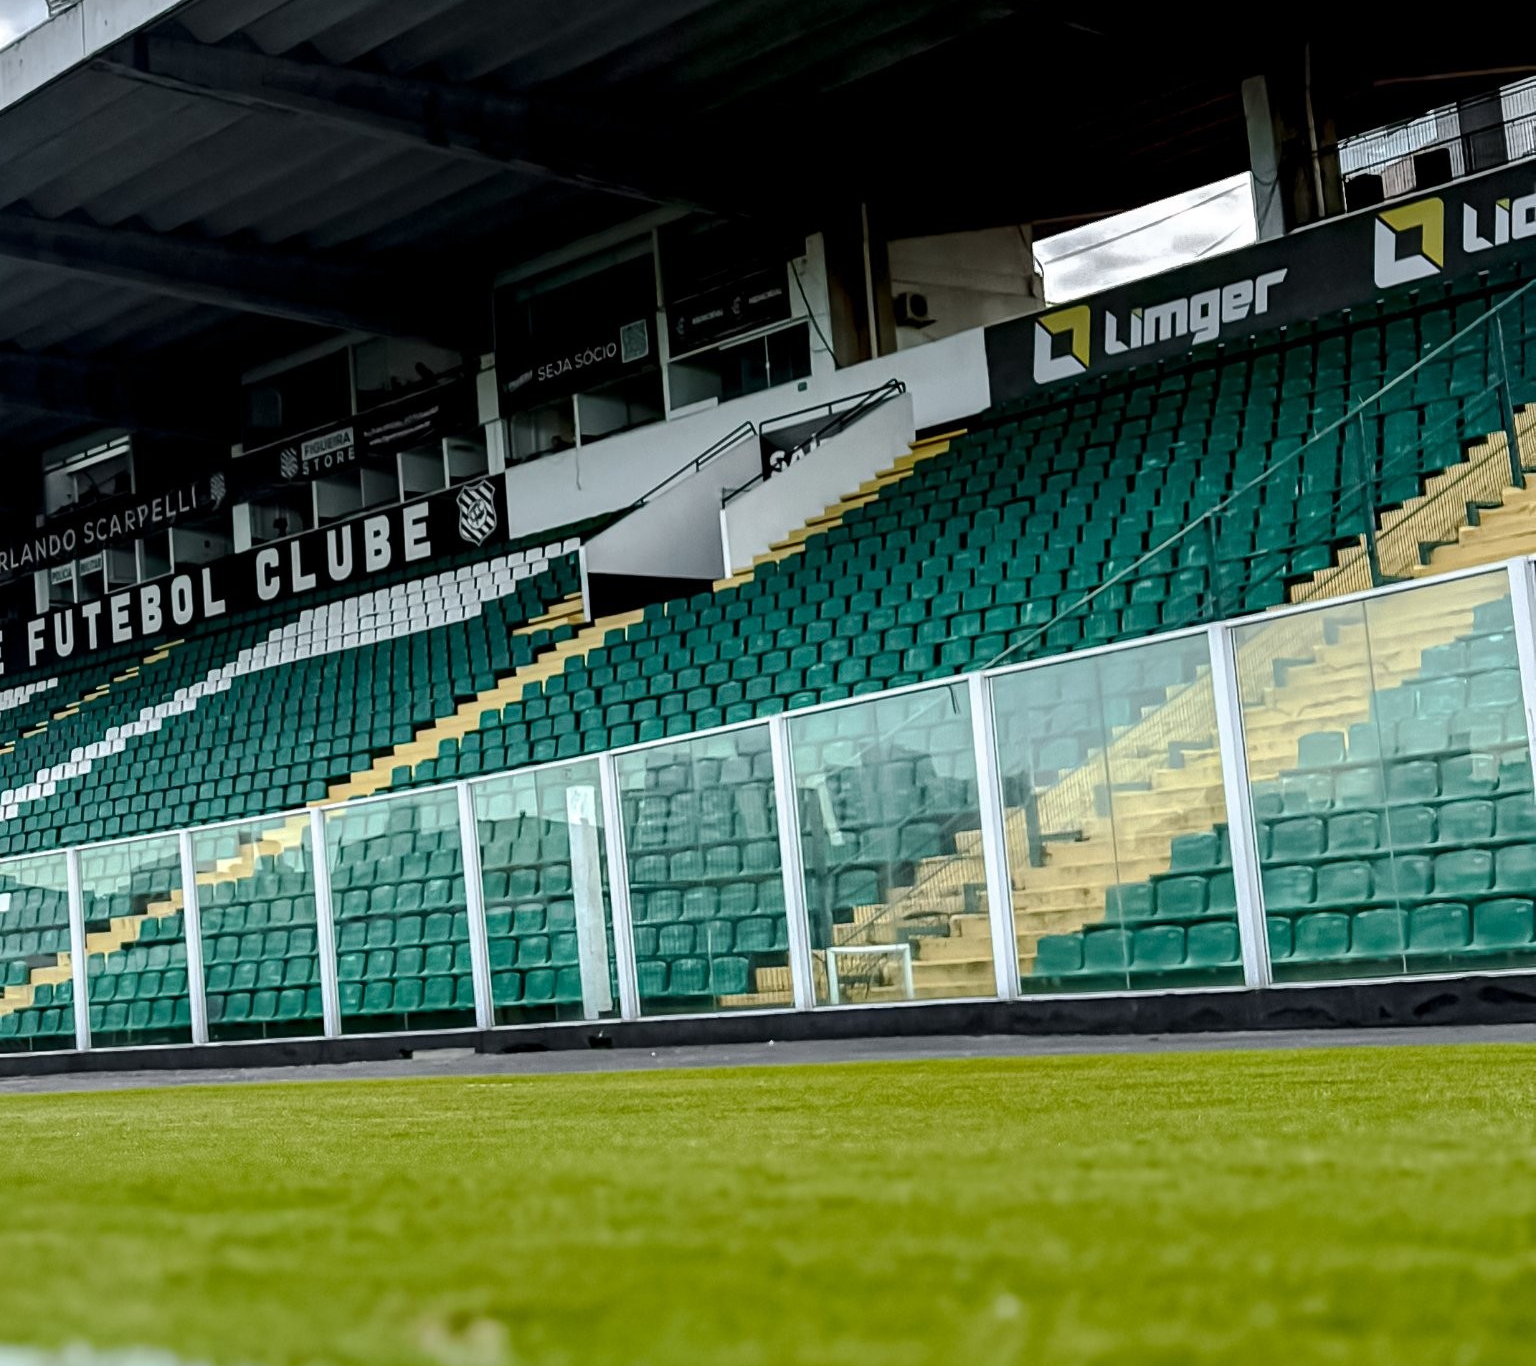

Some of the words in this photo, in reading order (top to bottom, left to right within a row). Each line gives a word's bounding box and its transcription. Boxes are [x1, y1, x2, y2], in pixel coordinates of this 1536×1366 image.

[1104, 268, 1288, 356] Limger
[537, 357, 572, 382] SEJA
[574, 341, 617, 369] SÓCIO
[302, 445, 356, 475] STORE
[83, 493, 197, 544] SCARPELLI
[27, 567, 226, 666] FUTEBOL
[256, 501, 431, 601] CLUBE
